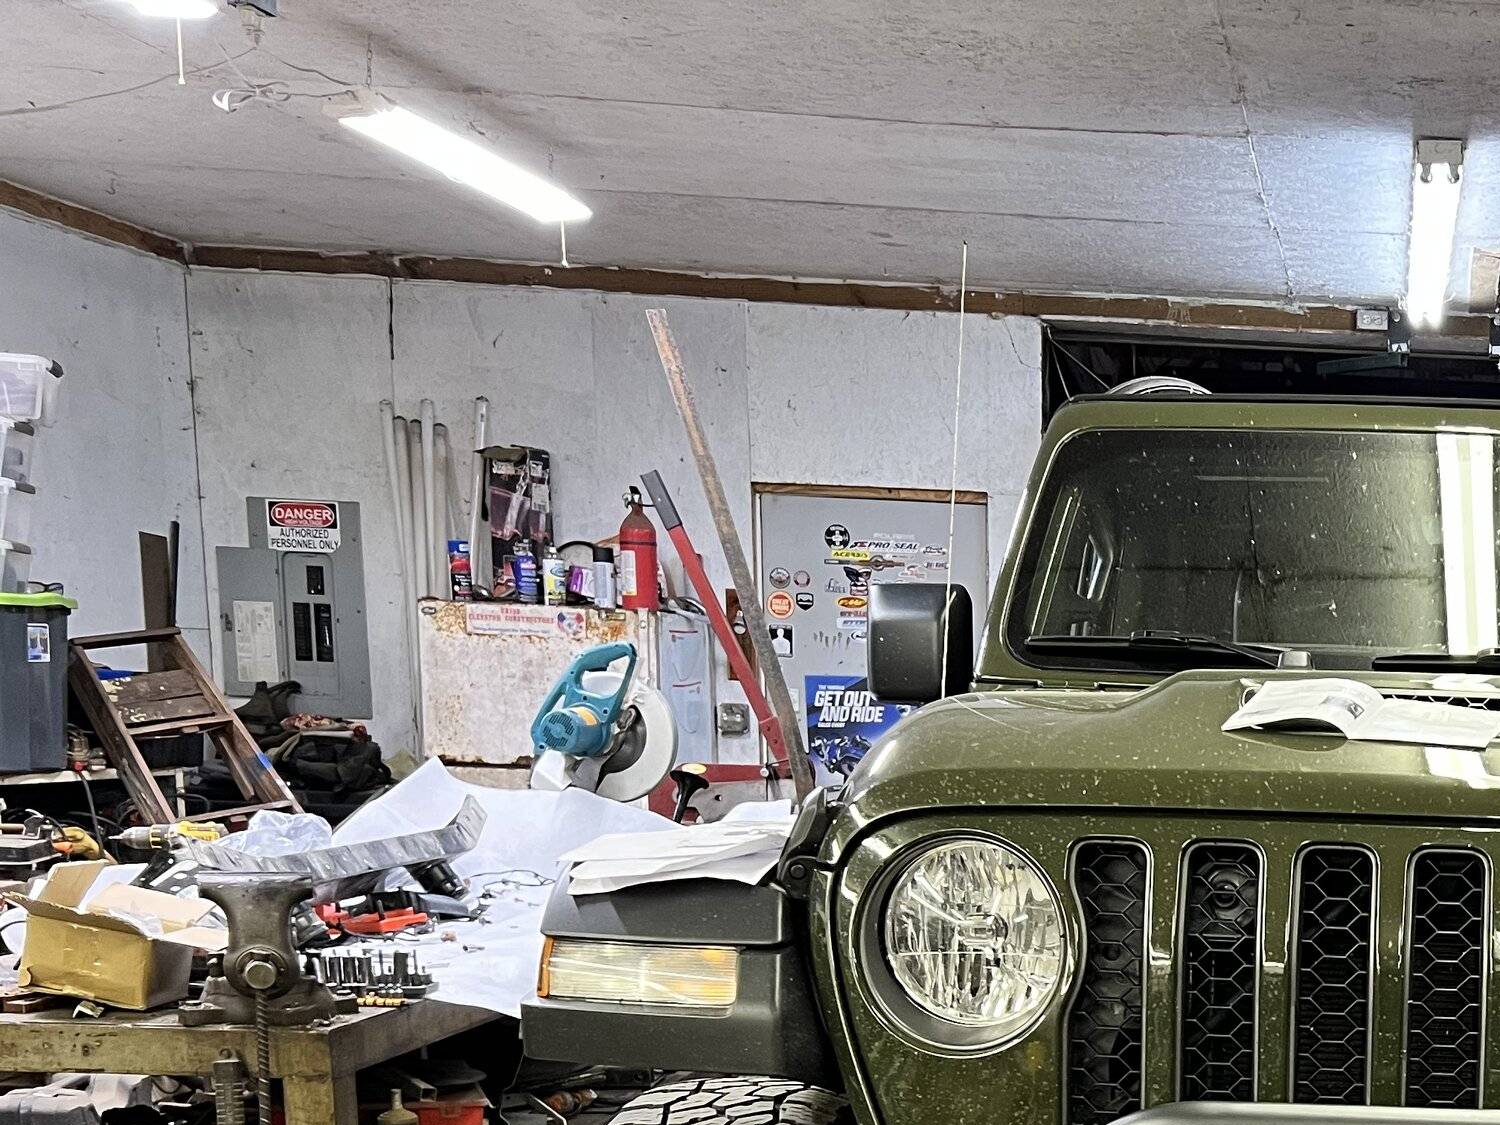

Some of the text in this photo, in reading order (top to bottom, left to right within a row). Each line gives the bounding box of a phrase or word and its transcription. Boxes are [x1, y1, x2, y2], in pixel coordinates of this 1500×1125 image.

[274, 507, 332, 521] DANGER
[279, 528, 329, 539] AUTHORIZED
[271, 538, 338, 551] PERSONNEL ONLY
[868, 541, 890, 549] PRO
[894, 541, 919, 550] SEAL
[814, 691, 872, 707] GET OUT
[819, 706, 885, 723] AND RIDE
